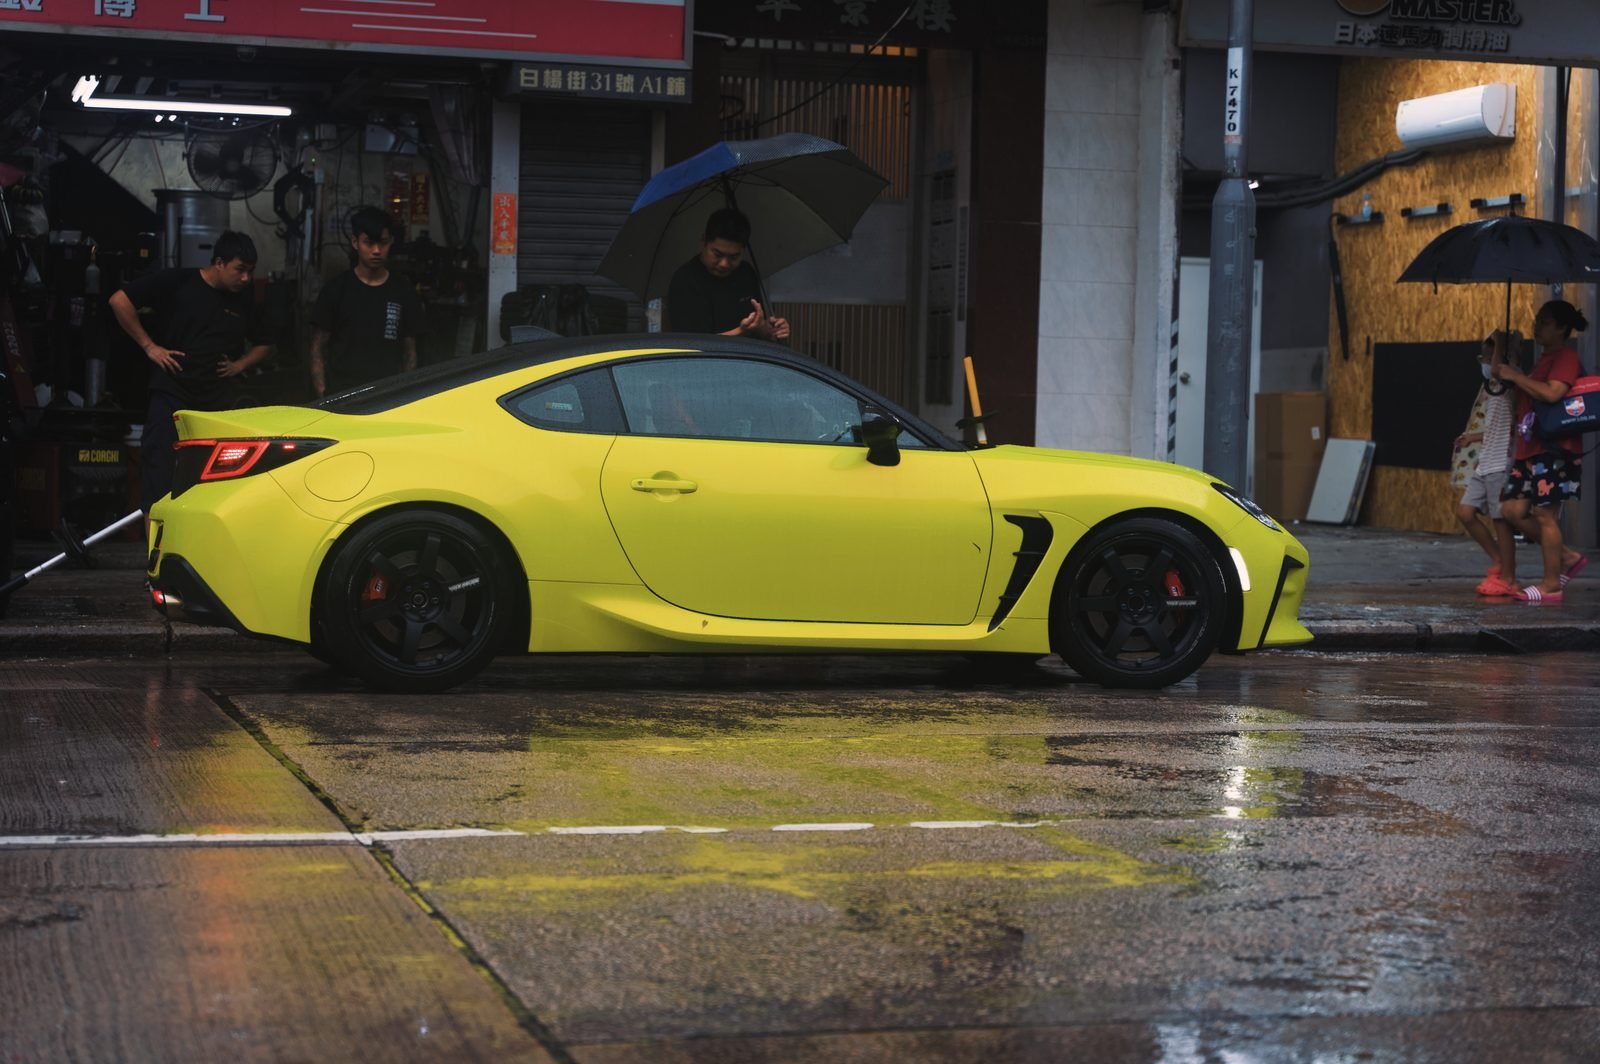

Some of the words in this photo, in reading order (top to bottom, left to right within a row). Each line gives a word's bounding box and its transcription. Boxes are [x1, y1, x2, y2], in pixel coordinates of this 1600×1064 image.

[1335, 22, 1509, 52] 日本速馬力潤滑油
[90, 449, 120, 463] CORGHI
